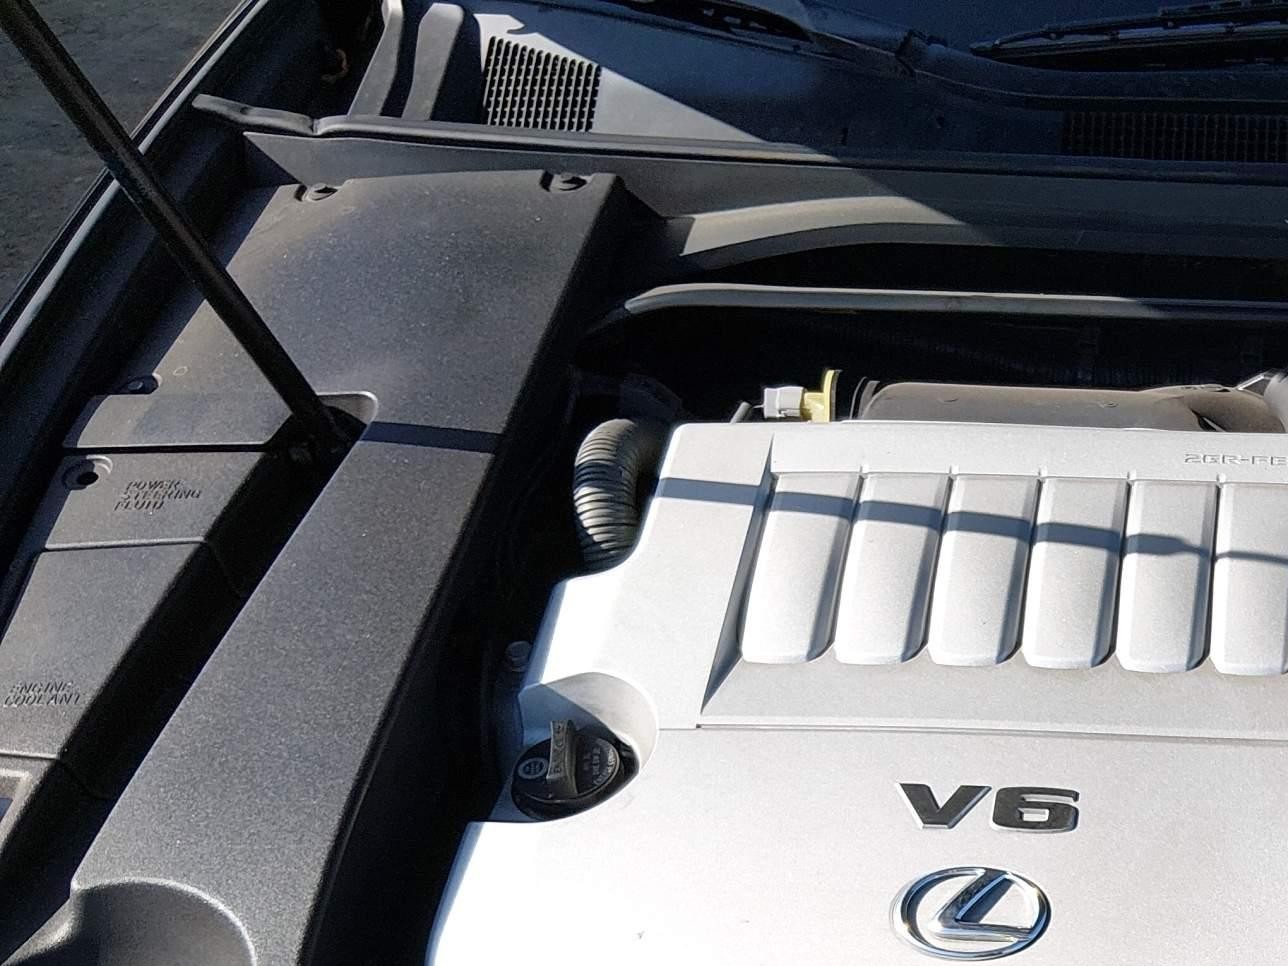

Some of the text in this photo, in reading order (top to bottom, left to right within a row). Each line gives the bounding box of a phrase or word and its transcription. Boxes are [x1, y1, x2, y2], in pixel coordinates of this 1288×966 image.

[1183, 453, 1288, 466] 2GR-FE
[125, 480, 181, 491] POWER
[121, 489, 202, 501] STEERING
[113, 500, 165, 511] FLUID
[9, 681, 75, 694] ENGINE
[4, 694, 81, 705] COOLANT
[897, 783, 1080, 833] V6
